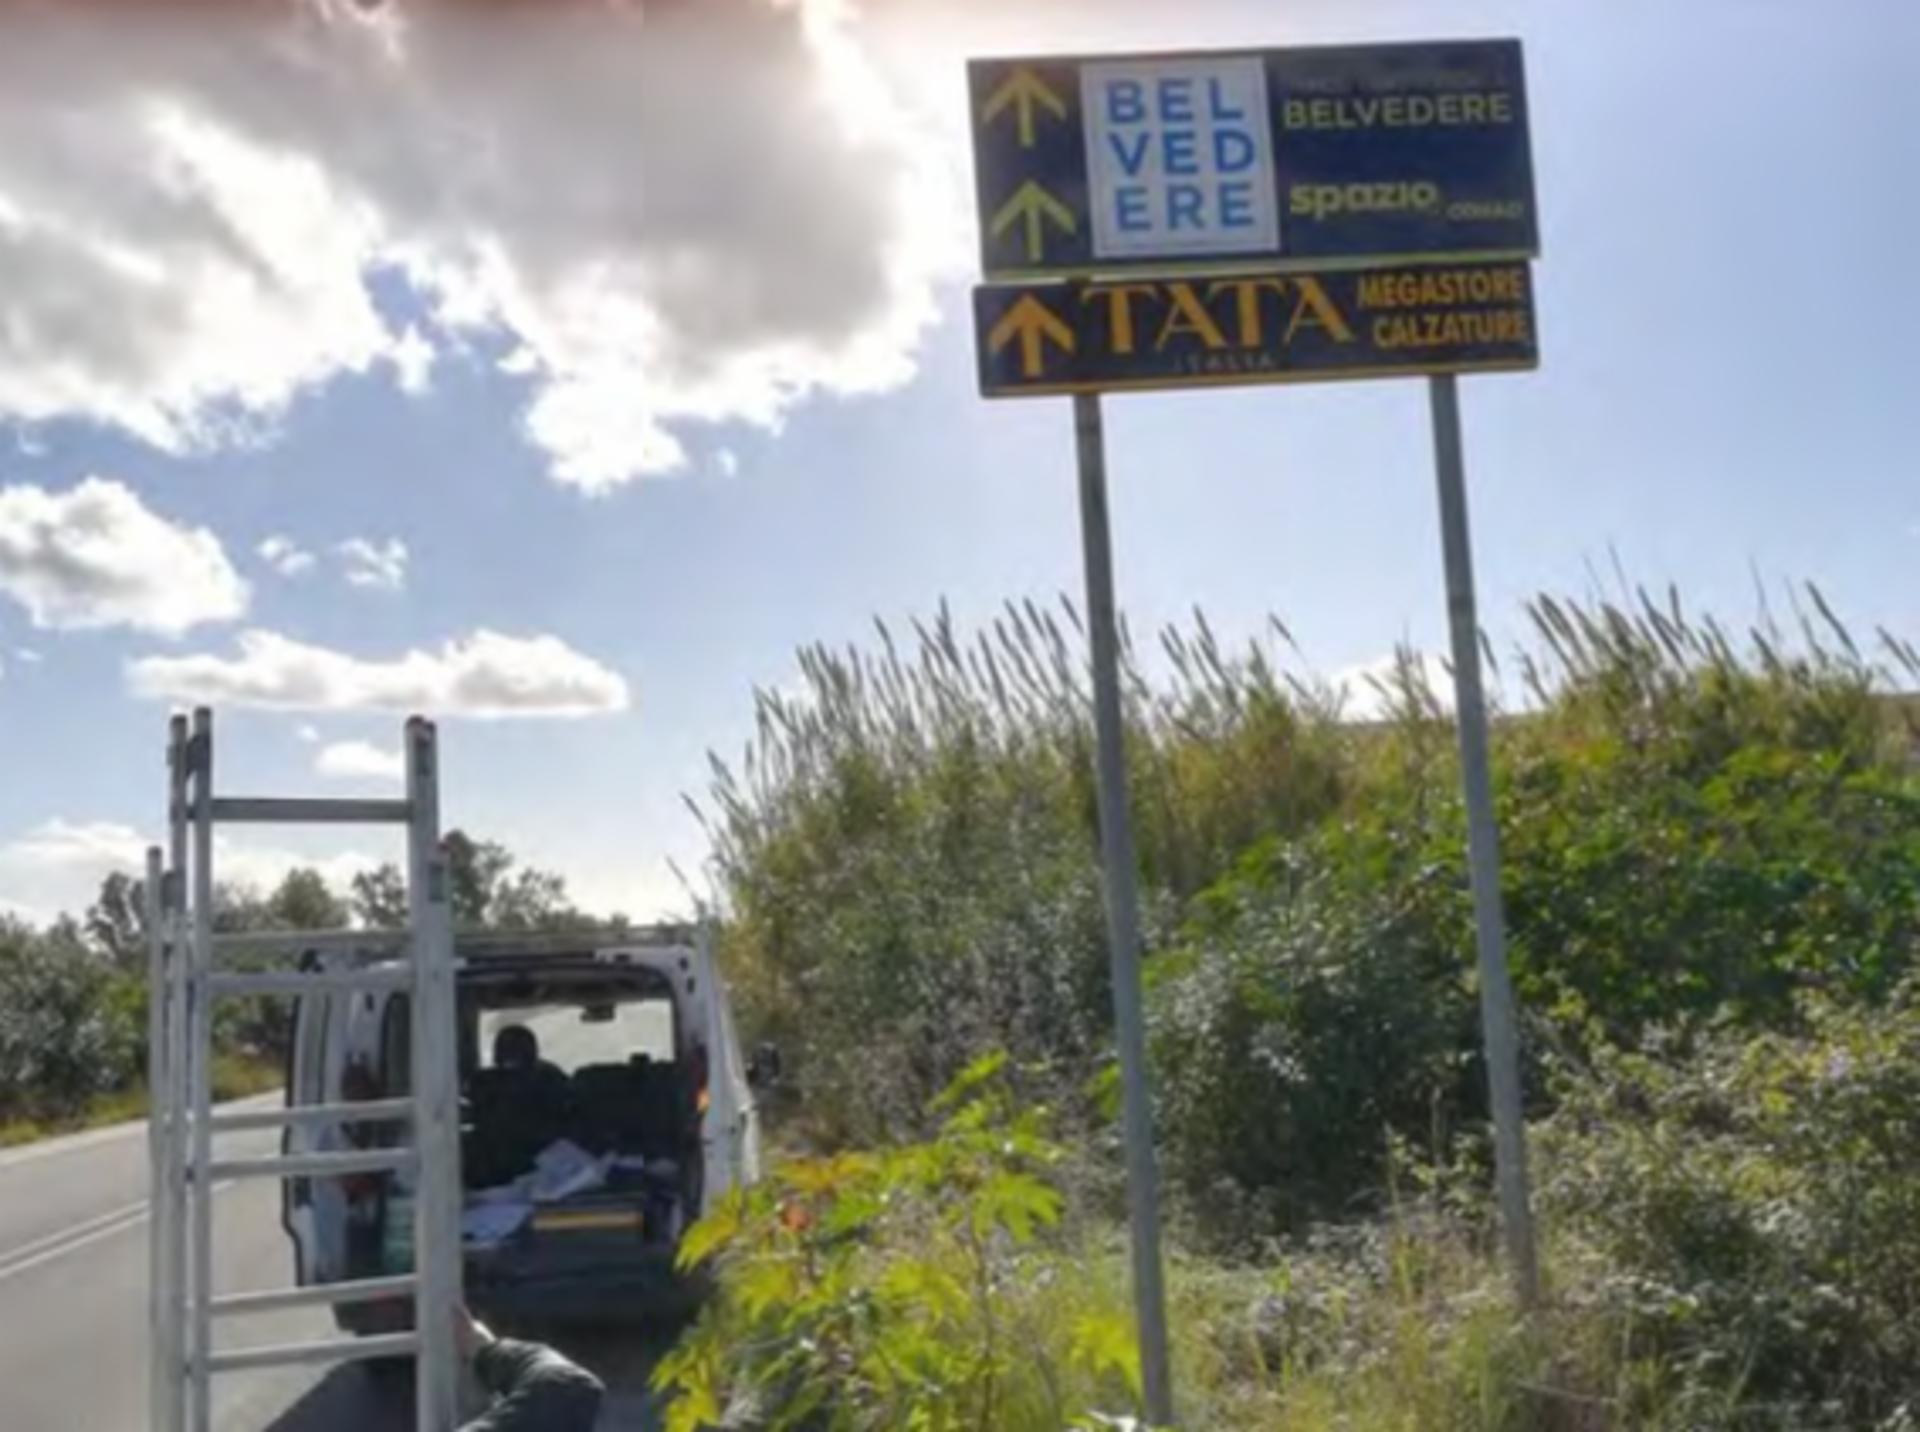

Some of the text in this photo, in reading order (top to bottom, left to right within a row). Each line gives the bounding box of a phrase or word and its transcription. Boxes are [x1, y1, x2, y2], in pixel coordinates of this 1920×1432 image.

[1106, 78, 1243, 124] BEL
[1283, 94, 1514, 129] BELVEDERE
[1107, 130, 1255, 177] VED
[1115, 182, 1255, 231] ERE
[1289, 182, 1440, 219] spazio
[1357, 268, 1524, 308] MEGASTORE
[1082, 275, 1358, 353] TATA
[1373, 310, 1531, 349] CALZATURE
